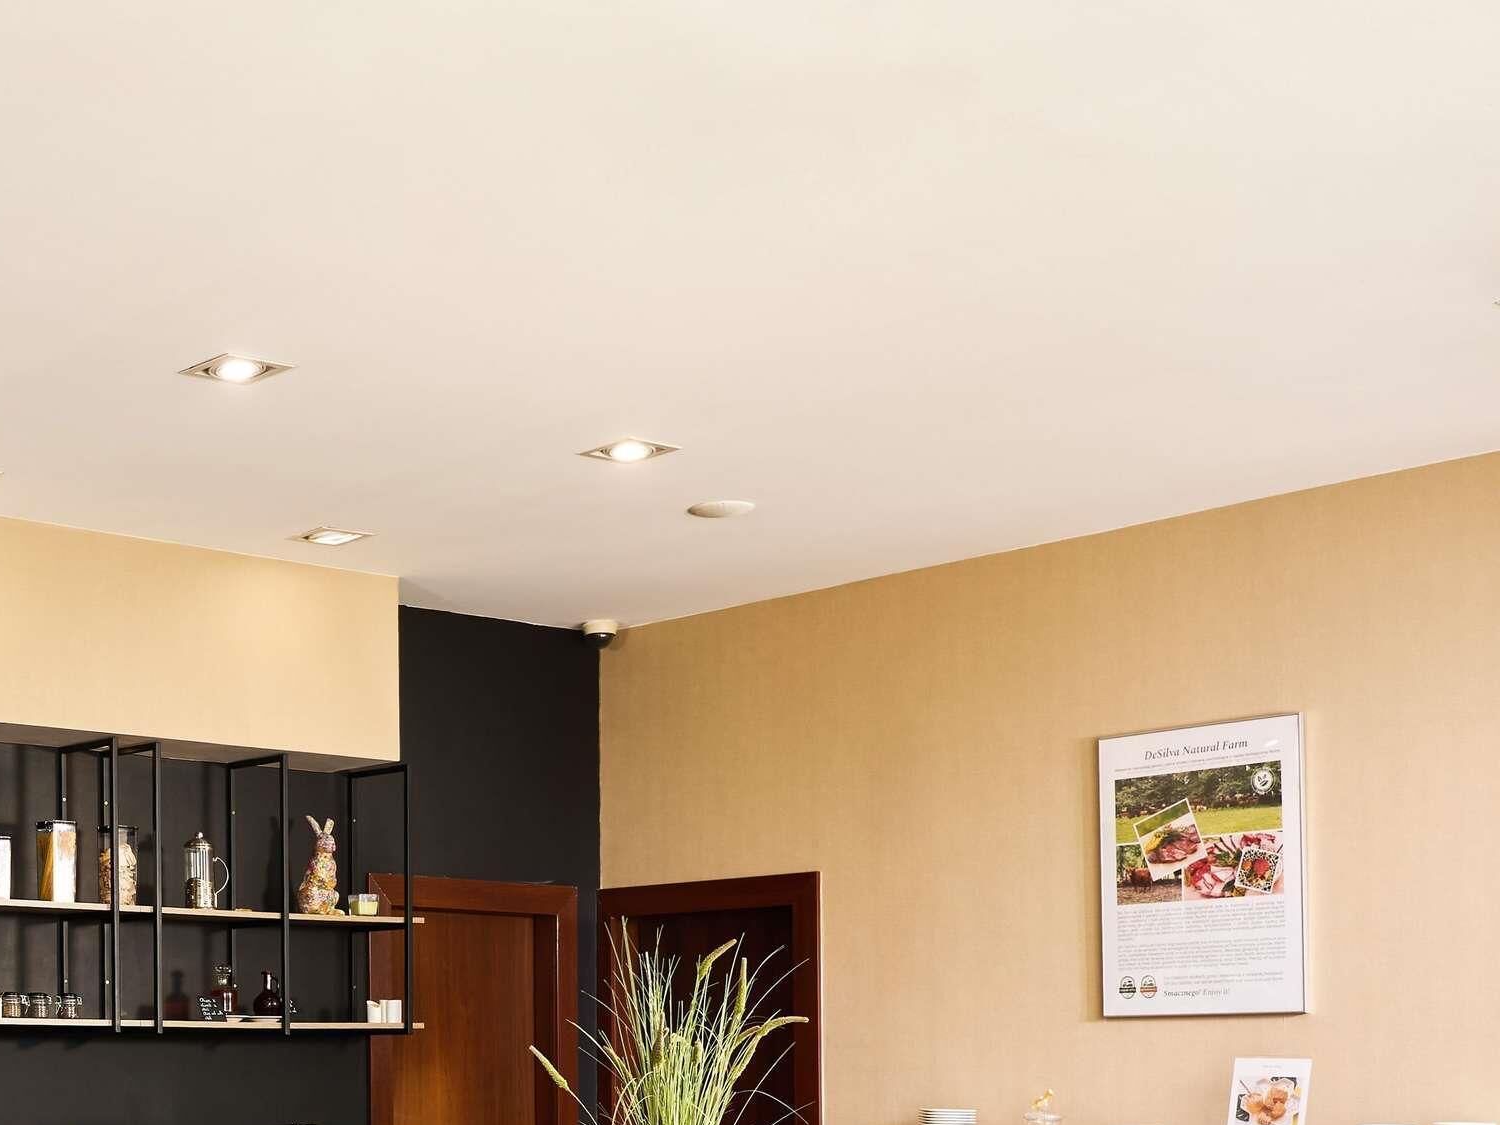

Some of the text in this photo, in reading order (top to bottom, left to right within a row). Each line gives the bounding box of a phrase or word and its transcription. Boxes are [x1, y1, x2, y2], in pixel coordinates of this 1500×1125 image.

[1144, 747, 1180, 761] DeSilva
[1182, 741, 1220, 755] Natural
[1222, 739, 1248, 750] Farm
